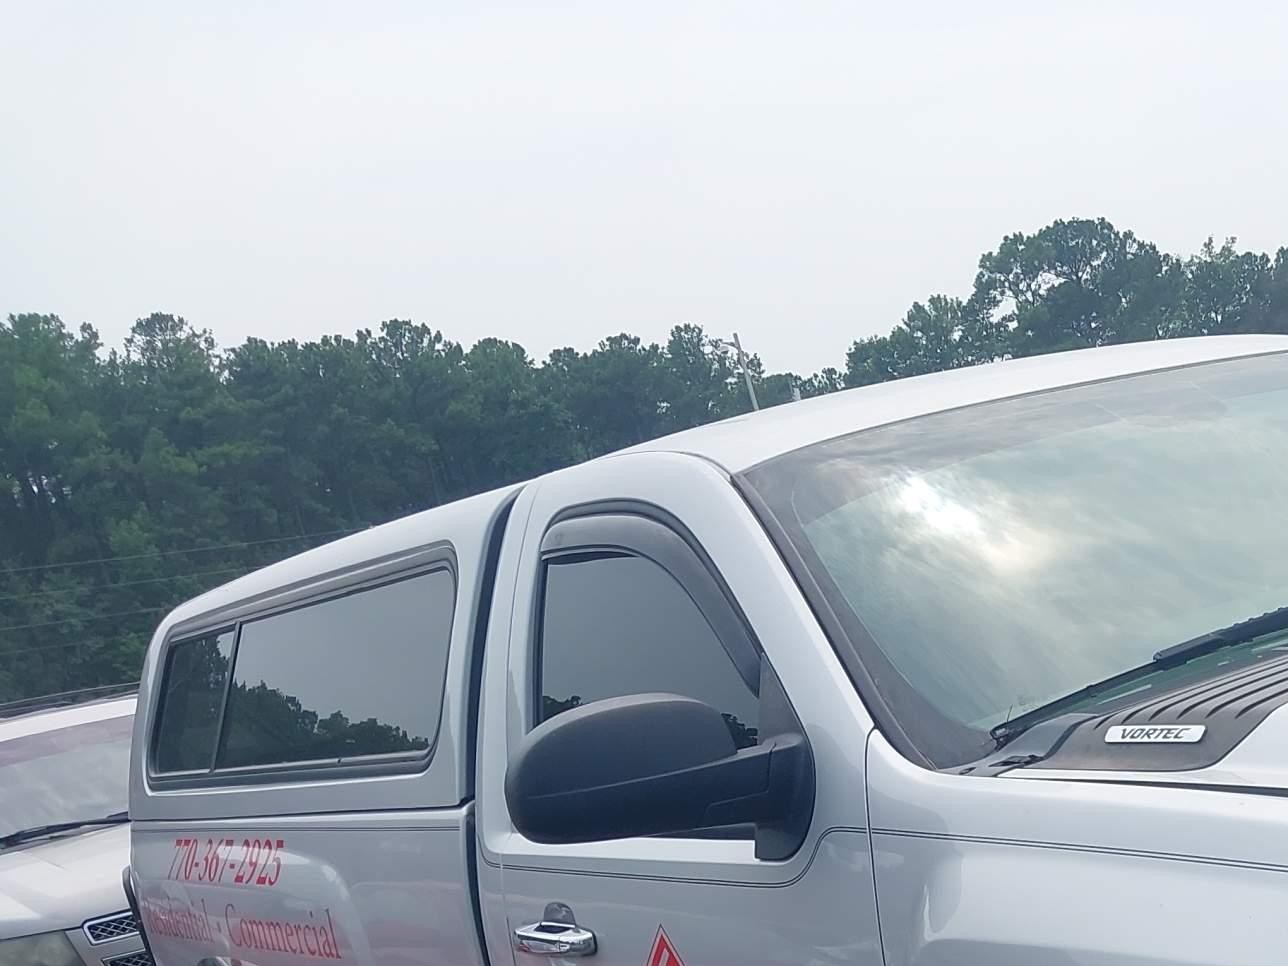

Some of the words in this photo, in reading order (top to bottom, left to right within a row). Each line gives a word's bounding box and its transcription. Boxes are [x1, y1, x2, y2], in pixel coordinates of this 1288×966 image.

[1120, 727, 1192, 740] VORTEC
[168, 838, 285, 887] 770-367-2925
[224, 903, 343, 960] Commercial
